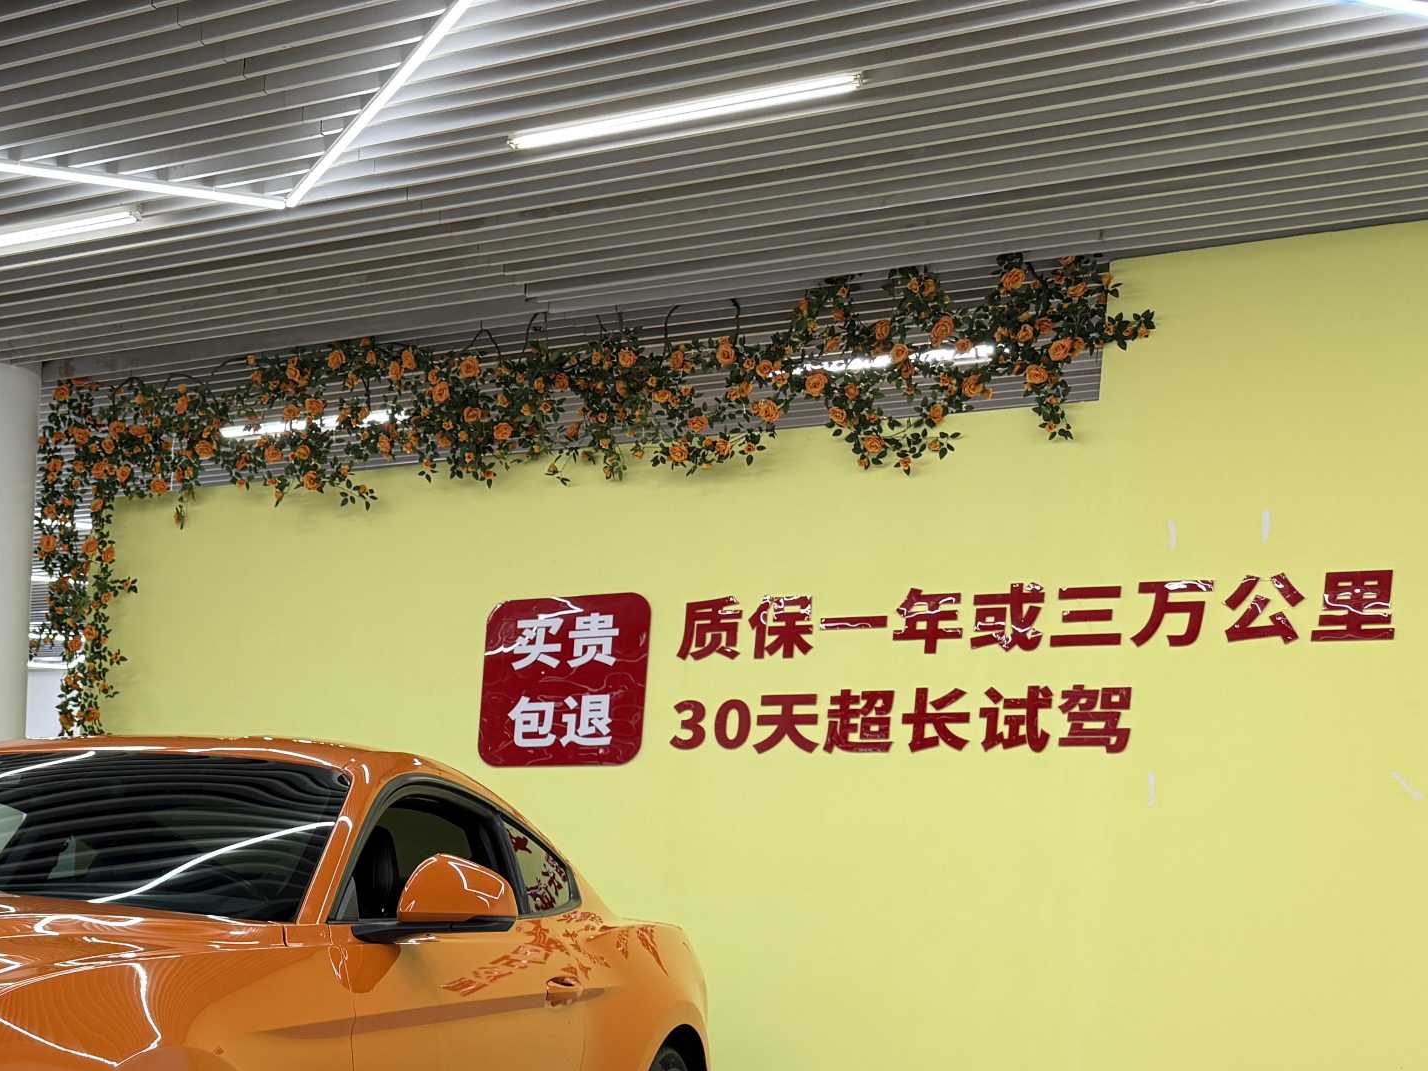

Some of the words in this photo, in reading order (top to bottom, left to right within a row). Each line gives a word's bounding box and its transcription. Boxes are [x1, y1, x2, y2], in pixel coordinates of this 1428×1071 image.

[510, 613, 619, 671] 买贵
[677, 570, 1395, 662] 质保一年或三万公里
[508, 695, 612, 747] 包退
[671, 684, 1133, 754] 30天超长试驾
